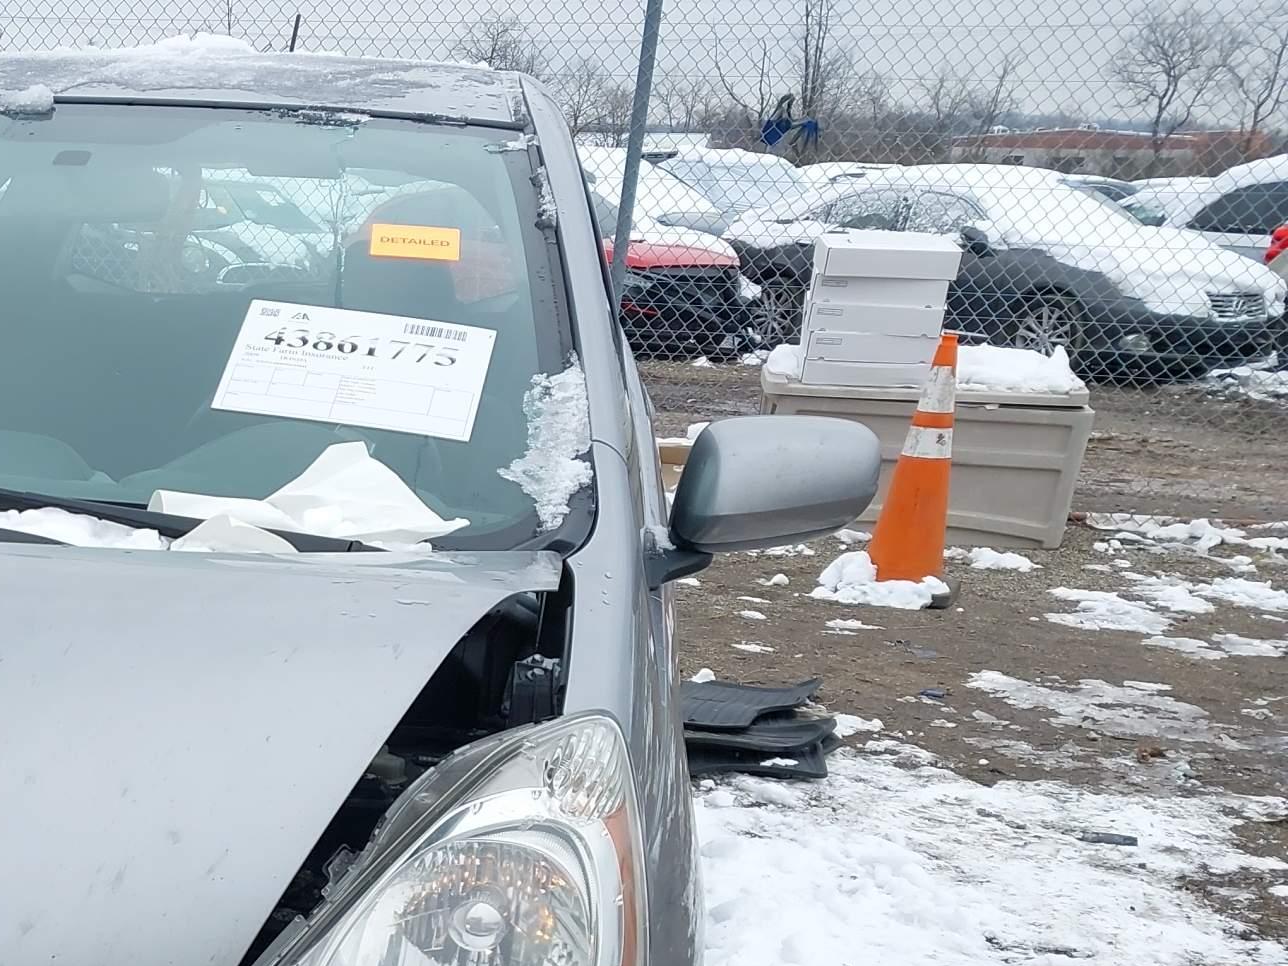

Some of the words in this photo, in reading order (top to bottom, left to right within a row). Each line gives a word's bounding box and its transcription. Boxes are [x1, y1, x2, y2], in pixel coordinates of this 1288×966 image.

[379, 235, 451, 248] DETAILED
[245, 344, 269, 353] State
[272, 345, 298, 356] Farm
[300, 349, 349, 361] Insurance
[263, 325, 461, 367] 43861775
